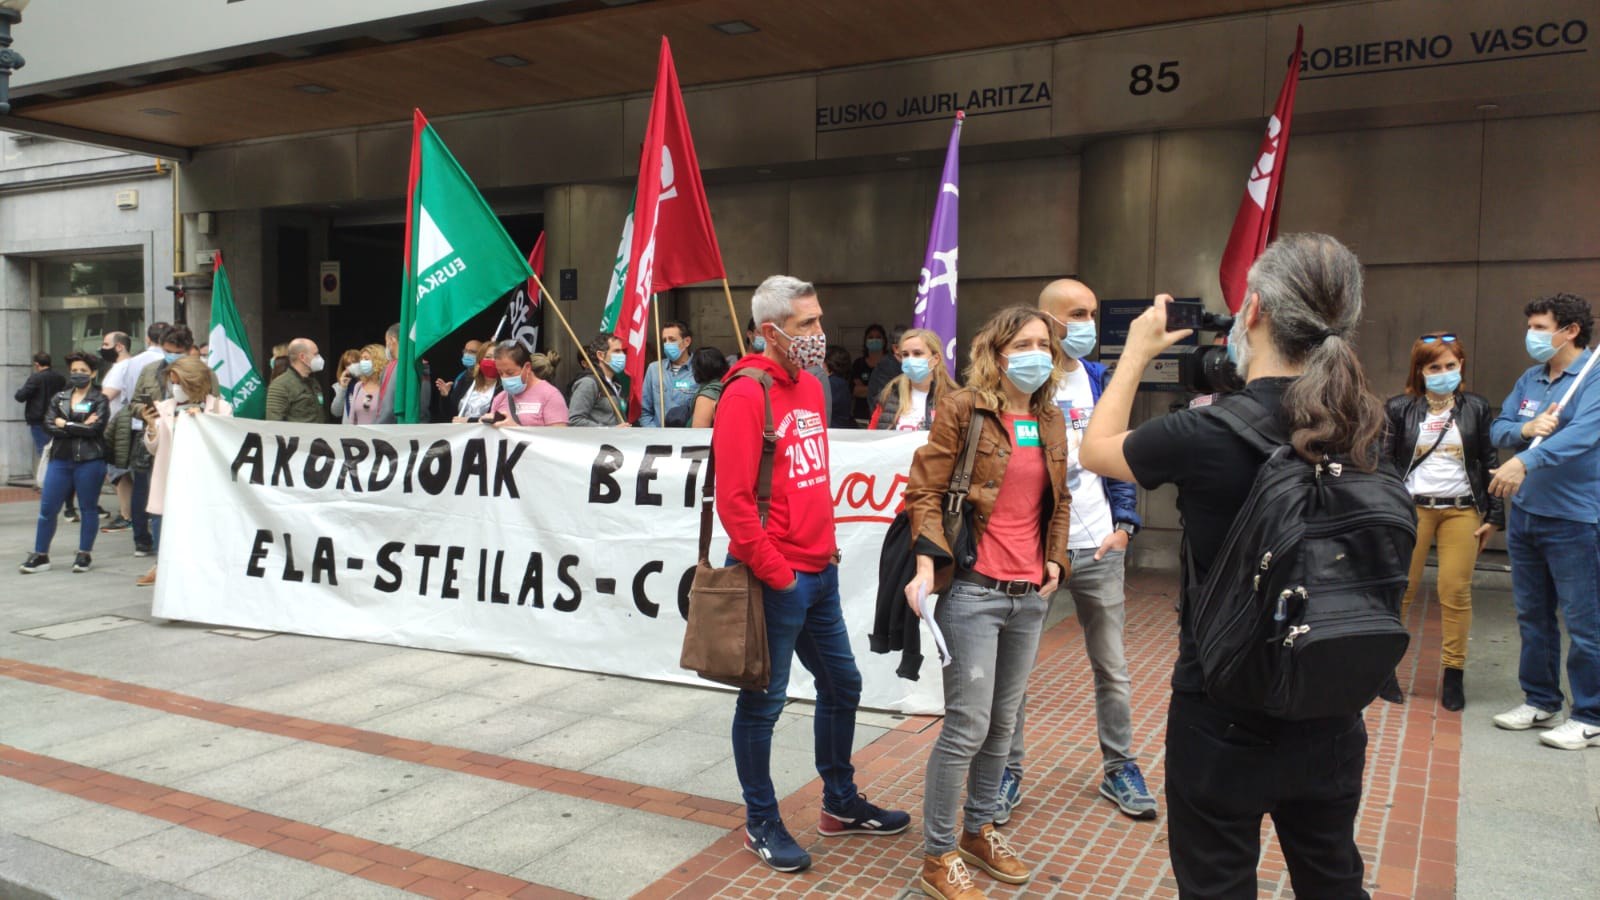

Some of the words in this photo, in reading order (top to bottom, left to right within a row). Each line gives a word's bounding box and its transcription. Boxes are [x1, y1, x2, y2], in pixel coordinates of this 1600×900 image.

[1288, 34, 1453, 73] GOBIERNO
[1470, 19, 1588, 55] VASCO
[1129, 61, 1180, 96] 85
[816, 101, 888, 126] EUSKO
[896, 81, 1051, 118] JAURLARITZA
[1073, 419, 1089, 429] ste
[231, 432, 531, 499] AKORDIOAK
[588, 443, 711, 508] BET
